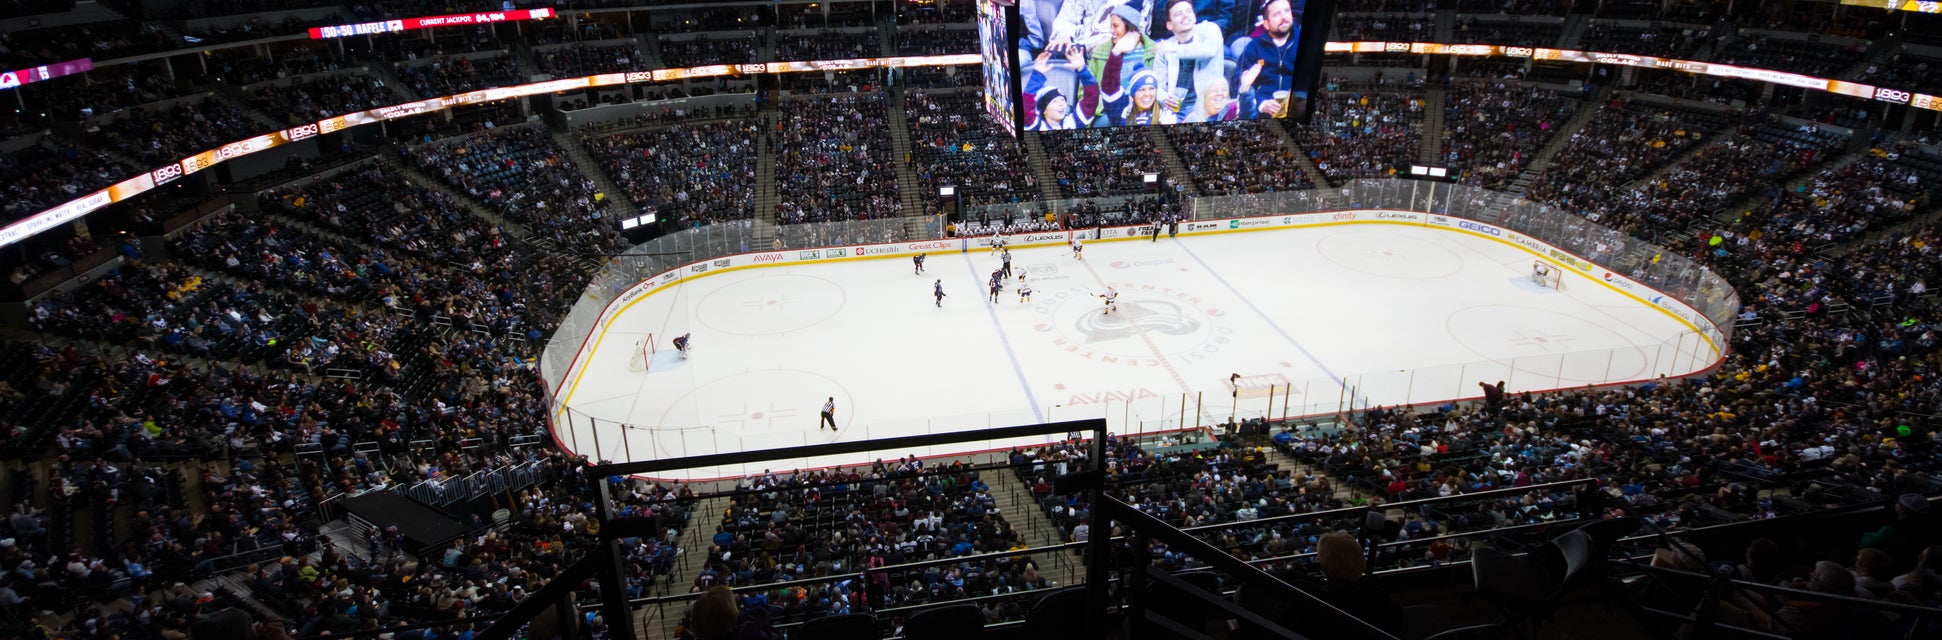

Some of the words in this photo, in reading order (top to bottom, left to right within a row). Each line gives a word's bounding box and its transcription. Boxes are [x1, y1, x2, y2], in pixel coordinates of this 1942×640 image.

[420, 17, 445, 26] CURRENT
[355, 21, 386, 35] RAFFLE
[1386, 42, 1410, 50] 1893
[1507, 47, 1532, 55] 1893
[1675, 62, 1691, 70] WITH
[627, 71, 651, 80] 1893
[441, 97, 456, 106] MADE
[459, 95, 472, 103] WITH
[1875, 87, 1910, 102] 1893
[290, 125, 317, 139] 1893
[215, 142, 254, 160] 1893
[184, 158, 208, 174] 1893
[153, 163, 182, 183] 1893
[1333, 212, 1358, 221] xfinity
[1459, 220, 1501, 236] GEICO
[865, 246, 900, 255] UCHealth
[909, 241, 931, 251] Great
[932, 239, 952, 249] Clips
[1516, 236, 1547, 253] CAMBRIA
[753, 253, 784, 263] AVAYA
[1613, 278, 1633, 290] pepsi
[622, 286, 643, 303] KeyBank
[1068, 387, 1160, 407] AVAYA
